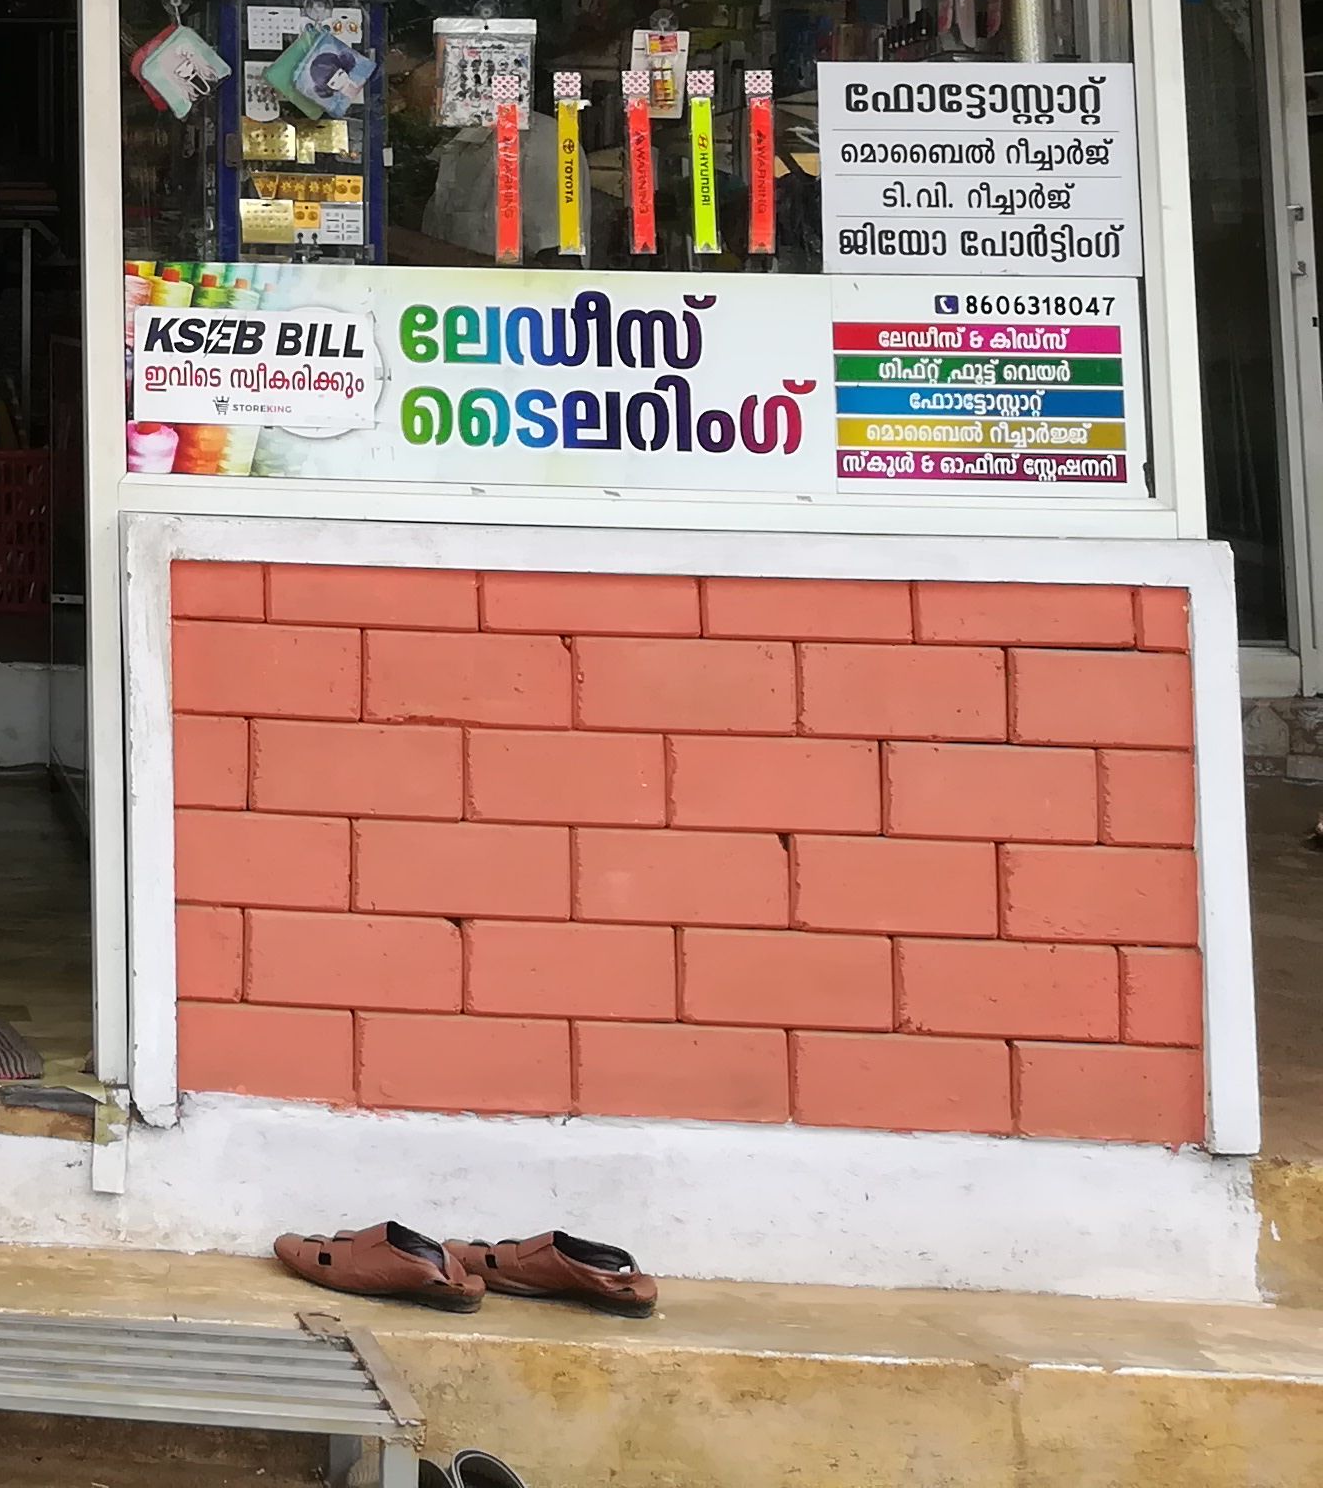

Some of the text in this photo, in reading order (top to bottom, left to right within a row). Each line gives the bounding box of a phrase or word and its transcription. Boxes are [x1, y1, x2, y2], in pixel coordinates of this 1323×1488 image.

[564, 158, 574, 204] TOYOTA
[699, 152, 712, 207] HYUNDAI
[839, 222, 947, 256] ജിയോ
[965, 295, 1116, 316] 8606318047
[144, 315, 365, 359] KSEB BILL
[399, 290, 717, 371] ലേഡീസ്
[878, 326, 965, 349] ലേഡീസ്
[969, 330, 985, 349] &
[144, 360, 222, 393] ഇവിടെ
[232, 403, 292, 414] STOREKING
[920, 455, 935, 473] &
